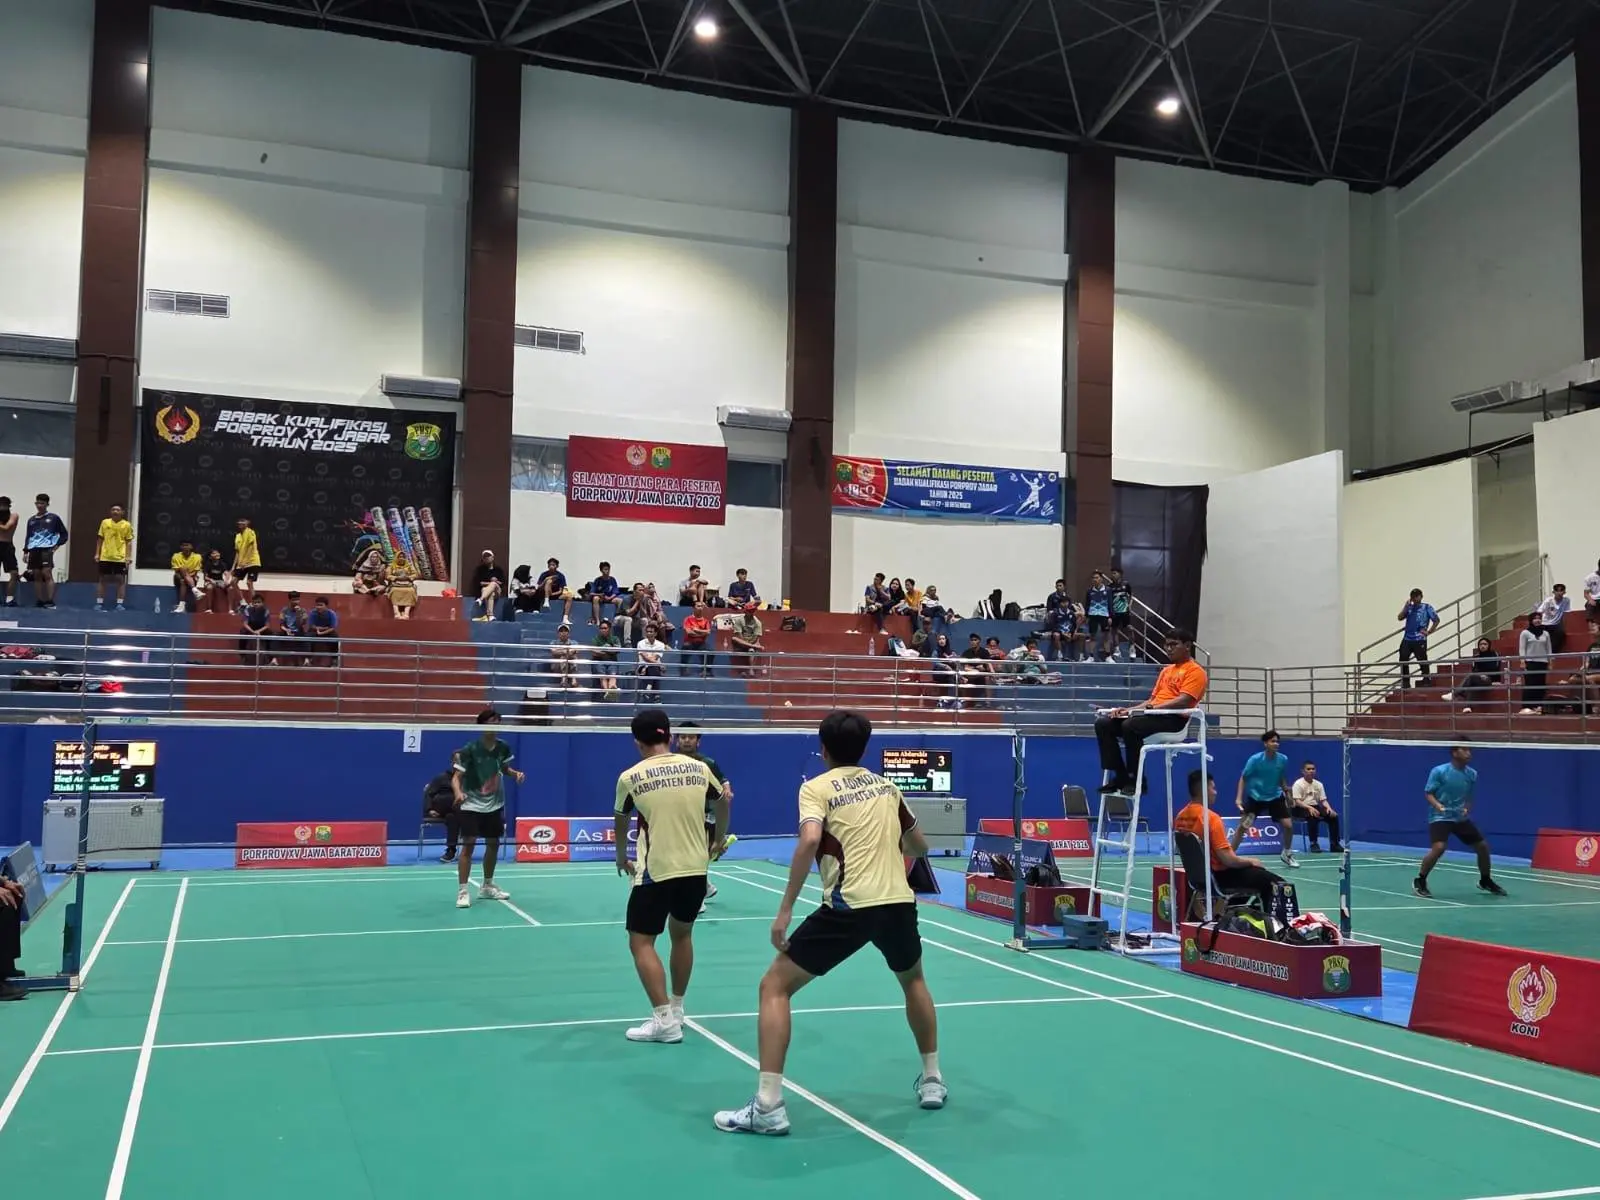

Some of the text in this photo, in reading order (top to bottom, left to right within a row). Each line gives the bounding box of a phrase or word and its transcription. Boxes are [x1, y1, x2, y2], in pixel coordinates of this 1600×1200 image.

[218, 410, 388, 433] BABAK KUALIFIKASI
[214, 422, 391, 444] PORPROV XV JABAR
[250, 435, 358, 453] TAHUN 2025
[896, 466, 995, 482] SELAMAT DATANG PESERTA
[572, 471, 721, 494] SELAMAT DATANG PARA PESERTA
[572, 487, 721, 509] PORPROV XV JAWA BARAT 2026
[948, 491, 963, 500] 2025
[408, 735, 416, 749] 2
[137, 749, 146, 758] 7
[938, 756, 946, 767] 3
[134, 774, 146, 788] 3
[630, 772, 645, 786] ML
[830, 779, 842, 792] B
[632, 777, 684, 797] KABUPATEN
[827, 788, 877, 811] KABUPATEN
[533, 829, 551, 838] AS
[1072, 840, 1090, 850] 2026
[242, 846, 382, 861] PORPROV XV JAWA BARAT 2026
[1235, 957, 1251, 971] JAWA
[1251, 960, 1272, 976] BARAT
[1272, 964, 1289, 981] 2026
[1511, 1022, 1540, 1038] KONI
